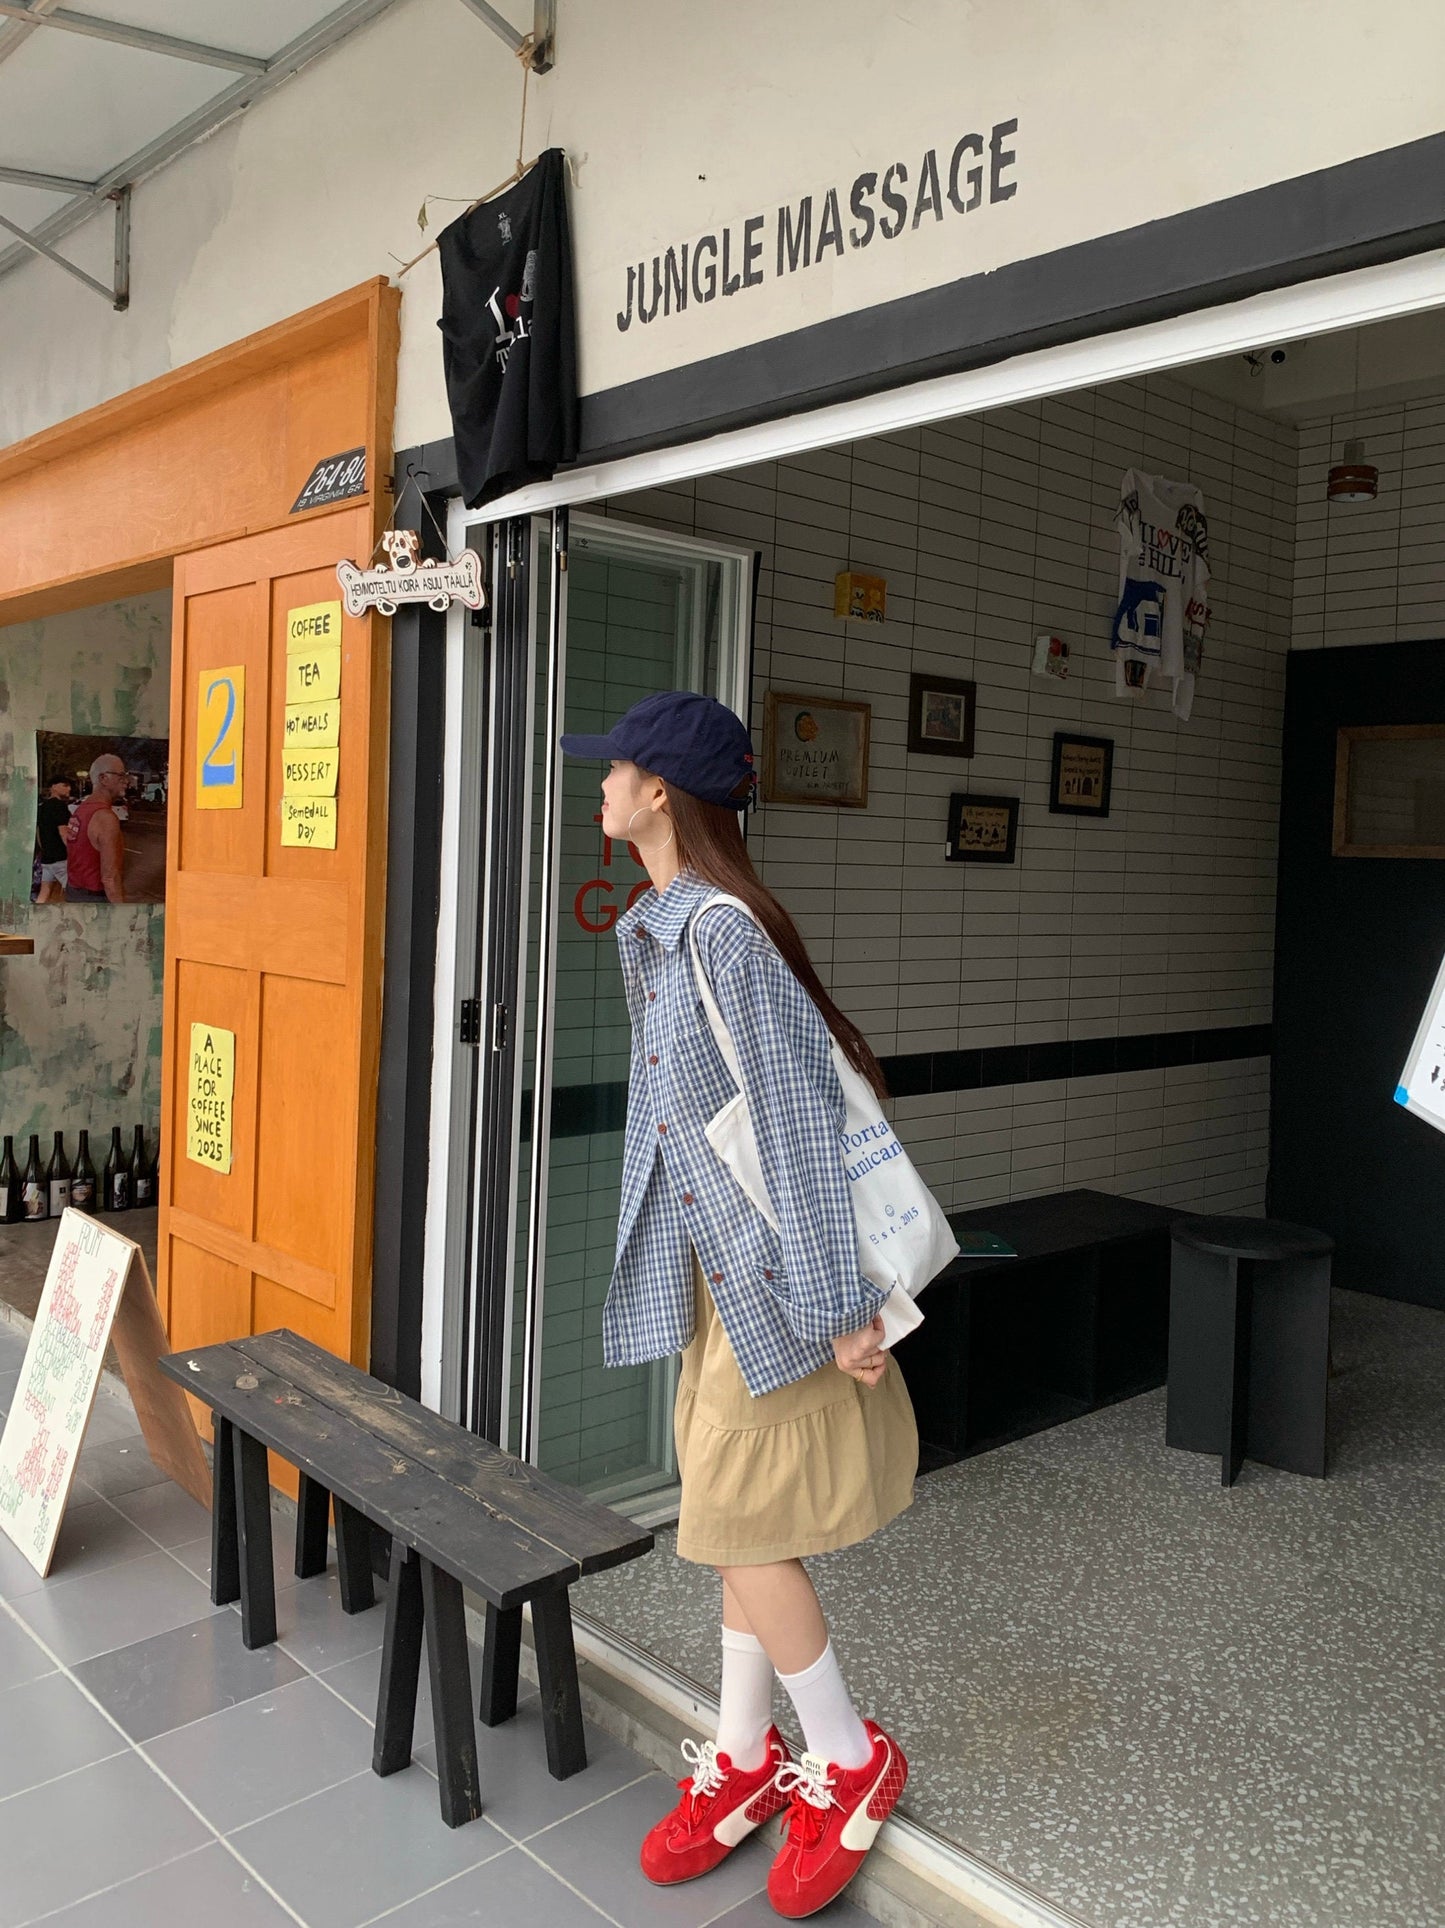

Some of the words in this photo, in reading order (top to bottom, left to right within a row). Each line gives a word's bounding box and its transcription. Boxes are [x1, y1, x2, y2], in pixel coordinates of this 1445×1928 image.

[617, 215, 764, 332] JUNGLE
[777, 118, 1018, 277] MASSAGE
[351, 579, 397, 597] HEMMOTELTU
[398, 577, 421, 593] KOIRA
[423, 575, 442, 590] ASUU
[291, 613, 331, 638] COFFEE
[298, 662, 320, 687] TEA
[202, 677, 236, 787] 2
[286, 717, 300, 736] HOT
[301, 712, 329, 732] MEALS
[780, 748, 839, 763] PREMIUM
[286, 762, 331, 782] DESSERT
[786, 766, 828, 779] OUTLET
[298, 823, 316, 843] Day
[204, 1033, 214, 1054] A
[194, 1052, 222, 1078] PLACE
[198, 1077, 217, 1097] FOR
[191, 1097, 225, 1122] COFFEE
[195, 1115, 221, 1138] SINCE
[839, 1120, 889, 1155] Porta
[197, 1139, 223, 1162] 2025
[78, 1222, 105, 1257] FRUIT
